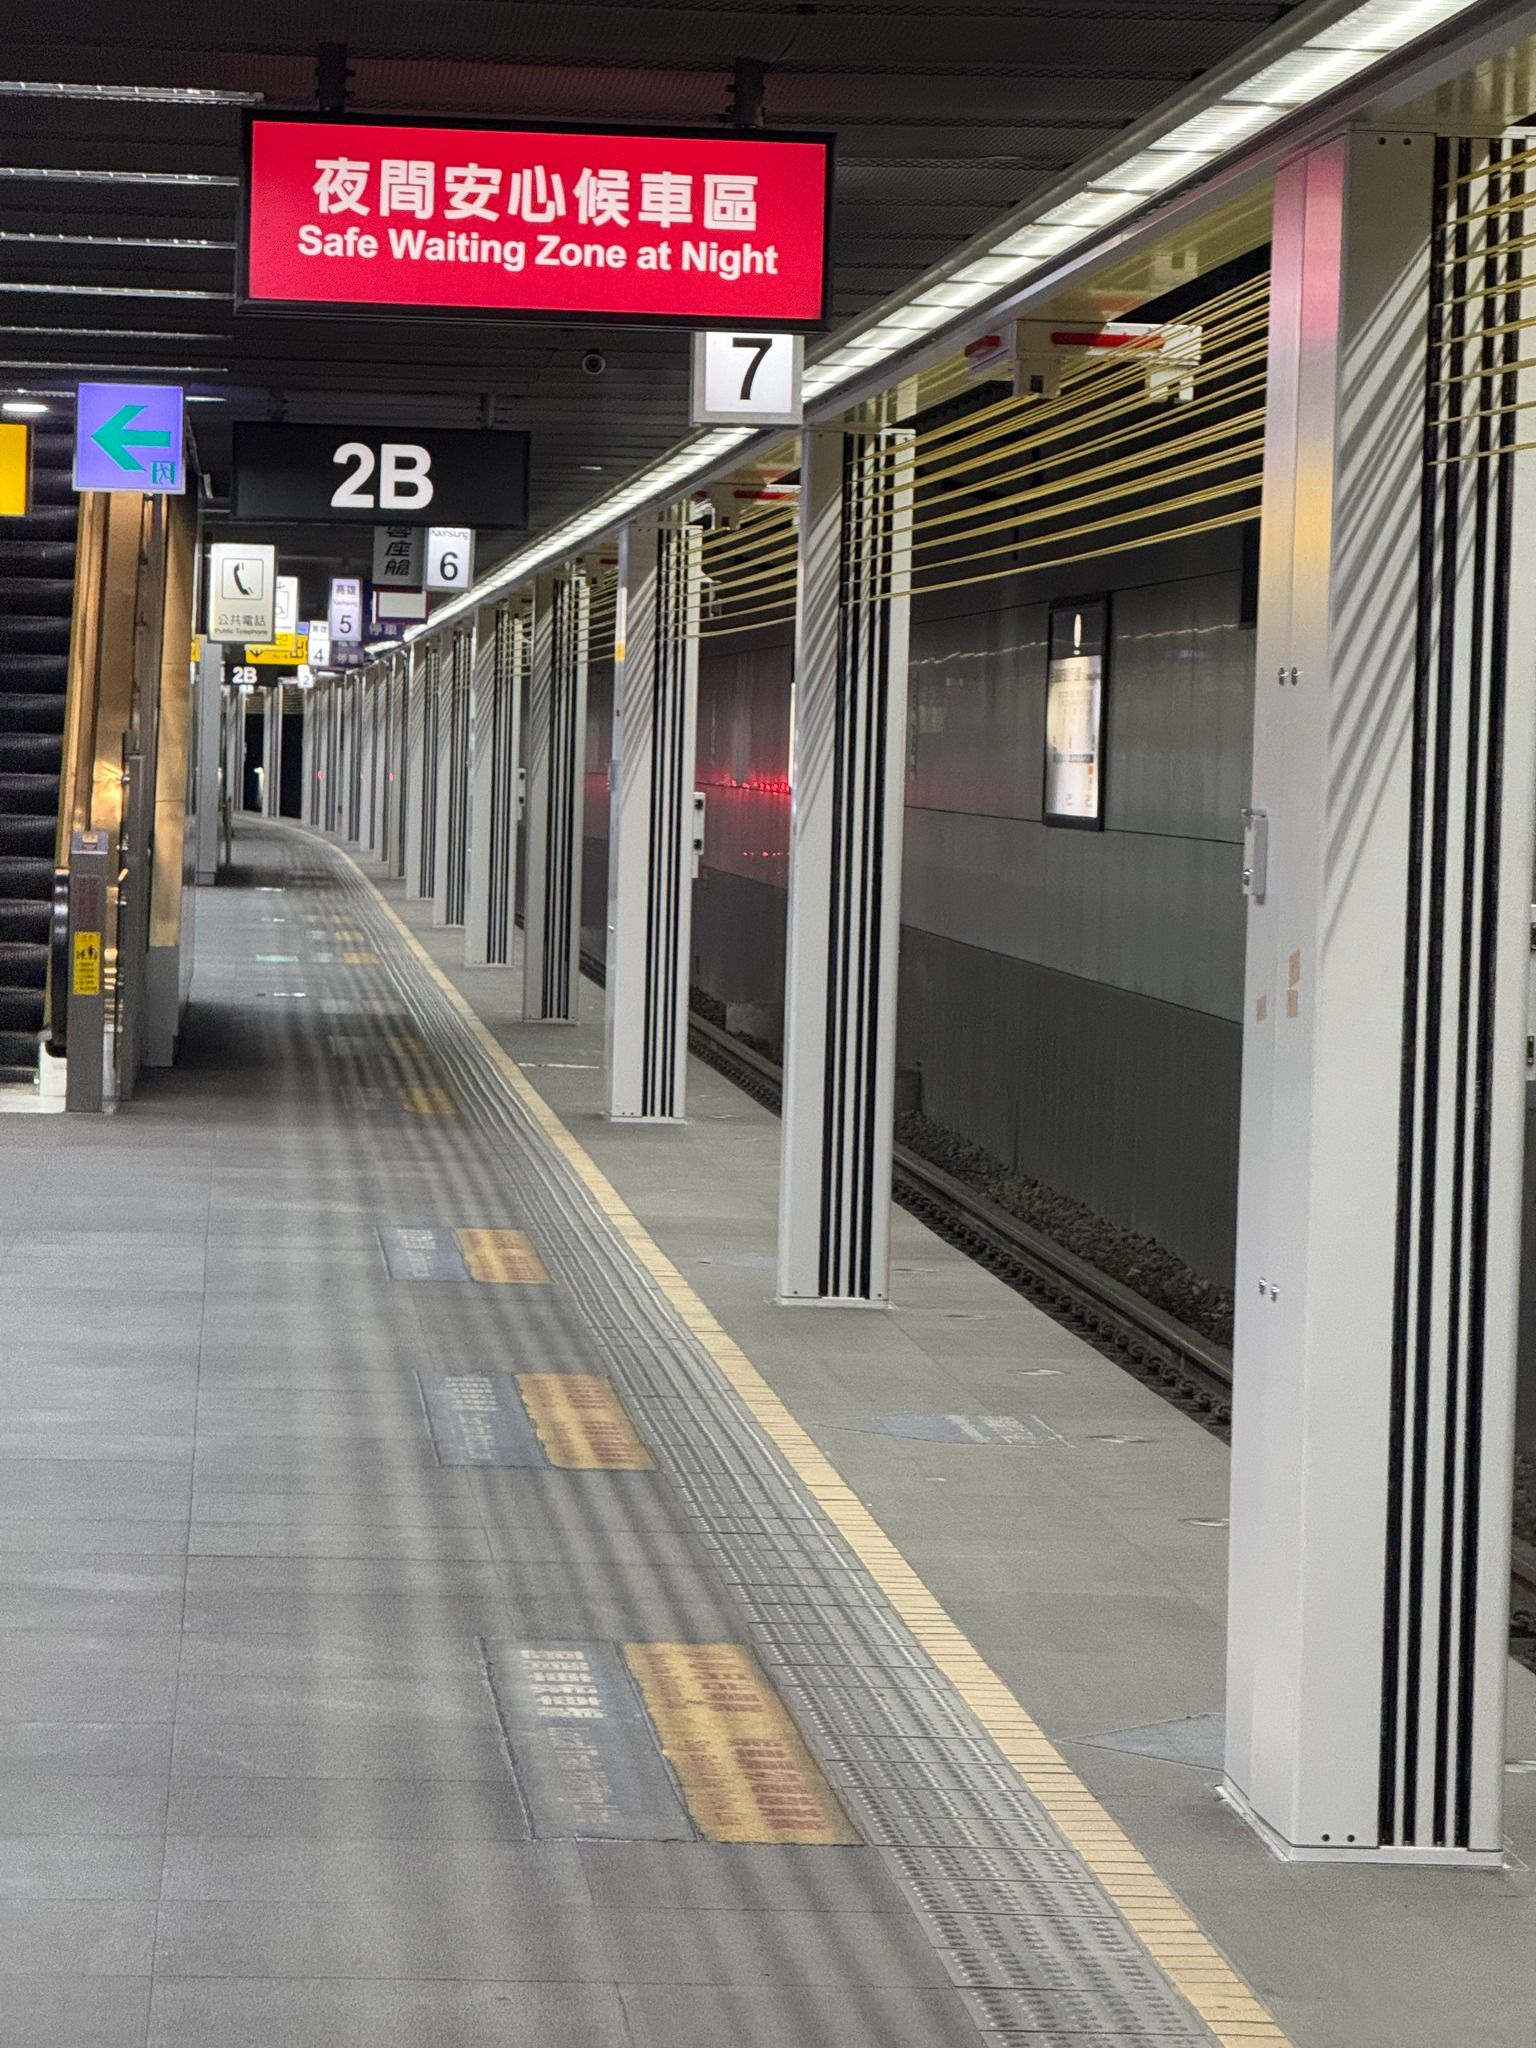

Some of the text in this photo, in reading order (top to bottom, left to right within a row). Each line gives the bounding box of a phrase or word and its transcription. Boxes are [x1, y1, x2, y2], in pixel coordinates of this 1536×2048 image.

[312, 156, 759, 232] 夜間安心候車區
[298, 224, 780, 281] Safe Waiting Zone at Night
[732, 337, 774, 401] 7
[330, 441, 434, 510] 2B
[440, 551, 459, 581] 6
[214, 627, 233, 635] Public
[236, 627, 269, 636] Telephone
[218, 613, 266, 627] 公共電話
[339, 614, 352, 634] 5
[313, 647, 325, 663] 4
[231, 665, 258, 684] 2B
